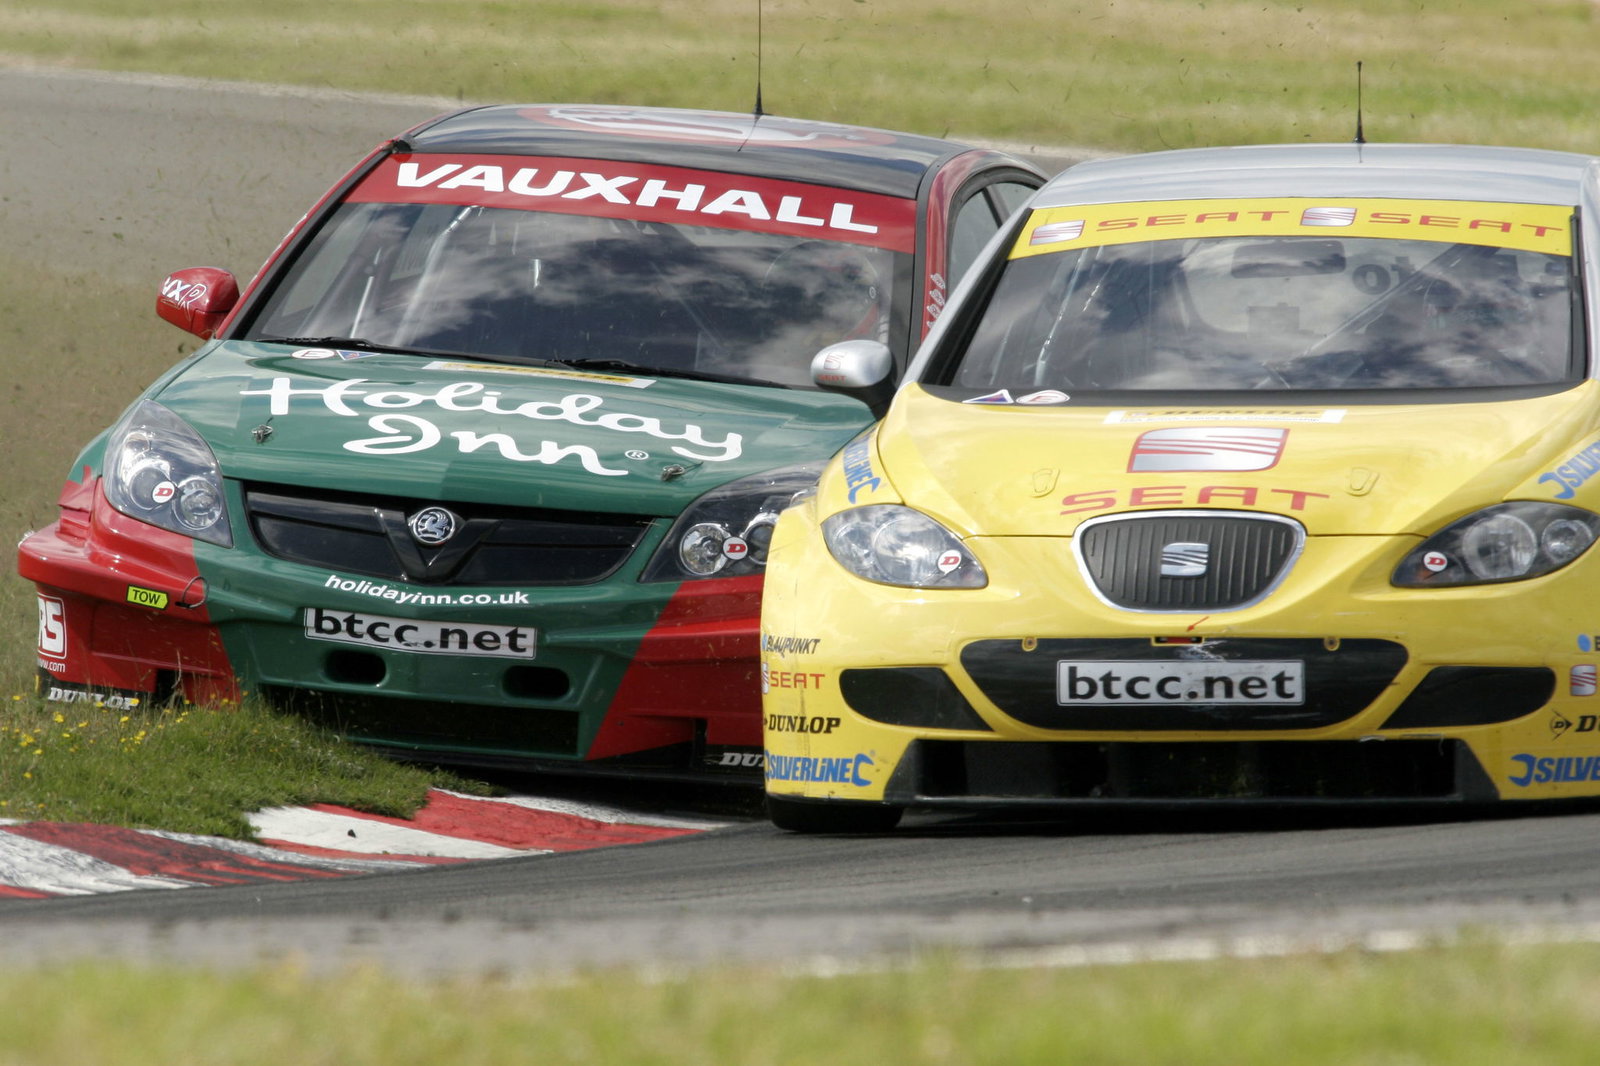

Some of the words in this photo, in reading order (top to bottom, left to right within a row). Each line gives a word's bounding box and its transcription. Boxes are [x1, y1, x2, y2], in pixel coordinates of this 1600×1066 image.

[397, 163, 878, 234] VAUXHALL
[1097, 211, 1290, 231] SEAT
[1369, 213, 1563, 237] SEAT
[162, 276, 206, 320] VXR
[240, 378, 742, 461] Holiday
[343, 414, 628, 476] Inn
[1060, 486, 1330, 515] SEAT
[133, 589, 160, 605] TOW
[324, 575, 530, 604] holidayinn.co.uk
[314, 608, 527, 653] btcc.net
[767, 636, 821, 658] BLAUPUNKT
[770, 671, 825, 689] SEAT
[1068, 666, 1296, 700] btcc.net
[768, 714, 840, 734] DUNLOP
[719, 752, 764, 767] DU
